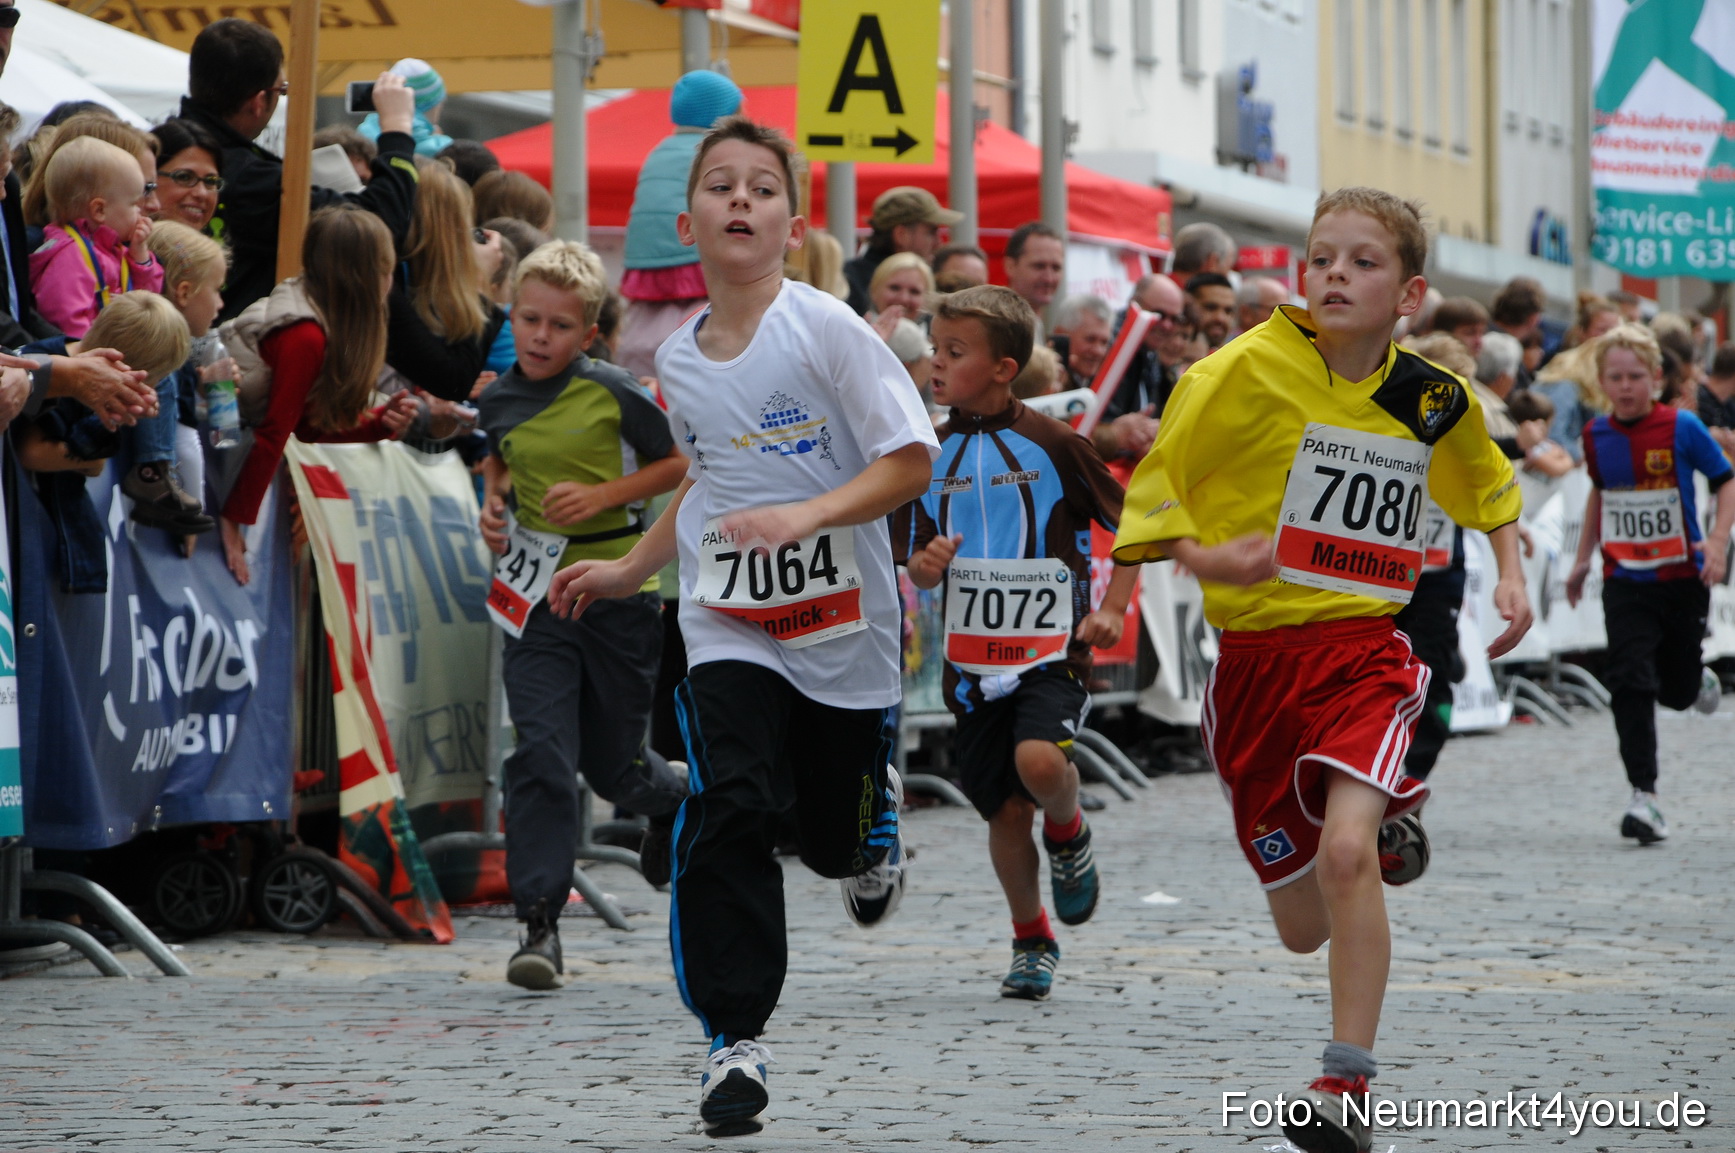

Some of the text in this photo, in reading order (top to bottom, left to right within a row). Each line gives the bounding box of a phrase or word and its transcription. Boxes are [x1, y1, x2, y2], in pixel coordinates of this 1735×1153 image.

[827, 14, 904, 114] A
[1303, 438, 1425, 475] PARTL Neumarkt
[1310, 465, 1422, 541] 7080
[1609, 508, 1672, 538] 7068
[714, 534, 839, 601] 7064
[950, 568, 1051, 583] PARTL Neumarkt
[1311, 541, 1407, 583] Matthias
[959, 587, 1057, 630] 7072
[987, 641, 1025, 661] Finn
